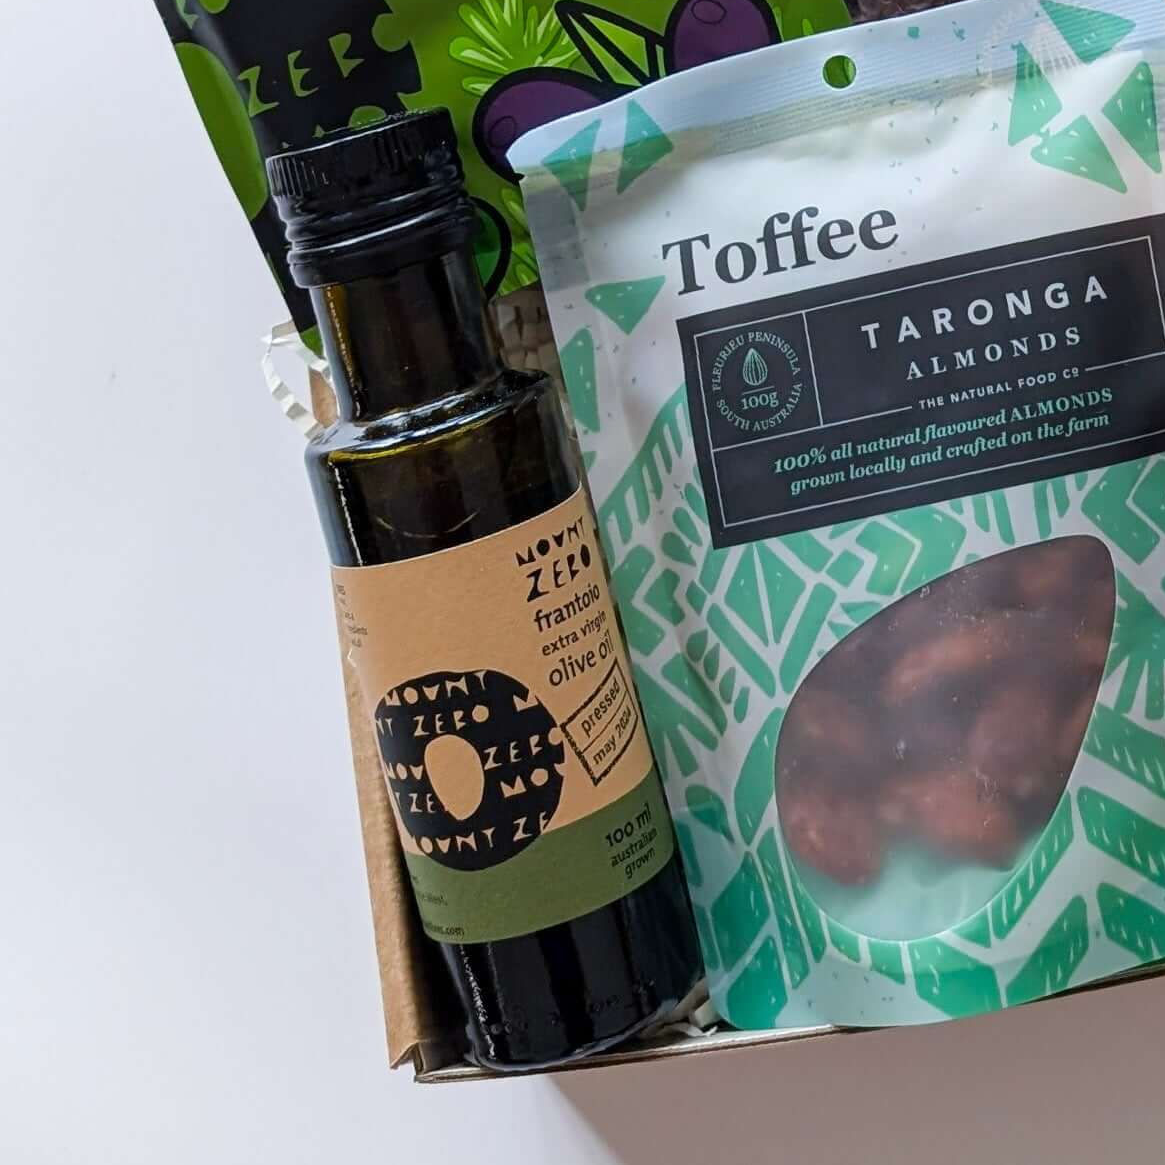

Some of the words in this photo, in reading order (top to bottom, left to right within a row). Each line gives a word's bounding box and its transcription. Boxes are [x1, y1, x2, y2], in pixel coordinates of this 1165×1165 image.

[662, 206, 898, 296] Toffee
[861, 276, 1107, 349] TARONGA
[712, 336, 744, 390] FLEURIEU
[748, 331, 800, 375] PENINSULA
[907, 326, 1080, 380] ALMONDS
[717, 399, 750, 430] SOUTH
[754, 383, 803, 431] AUSTRALIA
[741, 392, 780, 410] 100g
[919, 396, 944, 410] THE
[950, 380, 1012, 403] NATURAL
[1017, 372, 1056, 389] FOOD
[774, 447, 826, 474] 100%
[831, 442, 853, 460] all
[856, 434, 920, 455] natural
[921, 413, 1006, 444] flavoured
[1009, 388, 1113, 422] ALMONDS
[790, 471, 845, 495] grown
[849, 455, 905, 480] locally
[910, 447, 942, 466] and
[946, 433, 1007, 457] crafted
[1011, 430, 1033, 445] on
[1037, 423, 1062, 439] the
[1064, 414, 1110, 437] farm
[515, 516, 585, 566] MOUNT
[526, 544, 591, 603] ZERO
[534, 583, 600, 632] frantoio
[542, 631, 579, 656] extra
[580, 610, 606, 637] virgin
[549, 650, 597, 687] olive
[598, 628, 614, 659] oil
[581, 678, 620, 738] pressed
[593, 736, 617, 765] may
[605, 821, 634, 847] 100
[635, 802, 652, 825] ml
[611, 827, 658, 868] australian
[625, 847, 656, 879] grown
